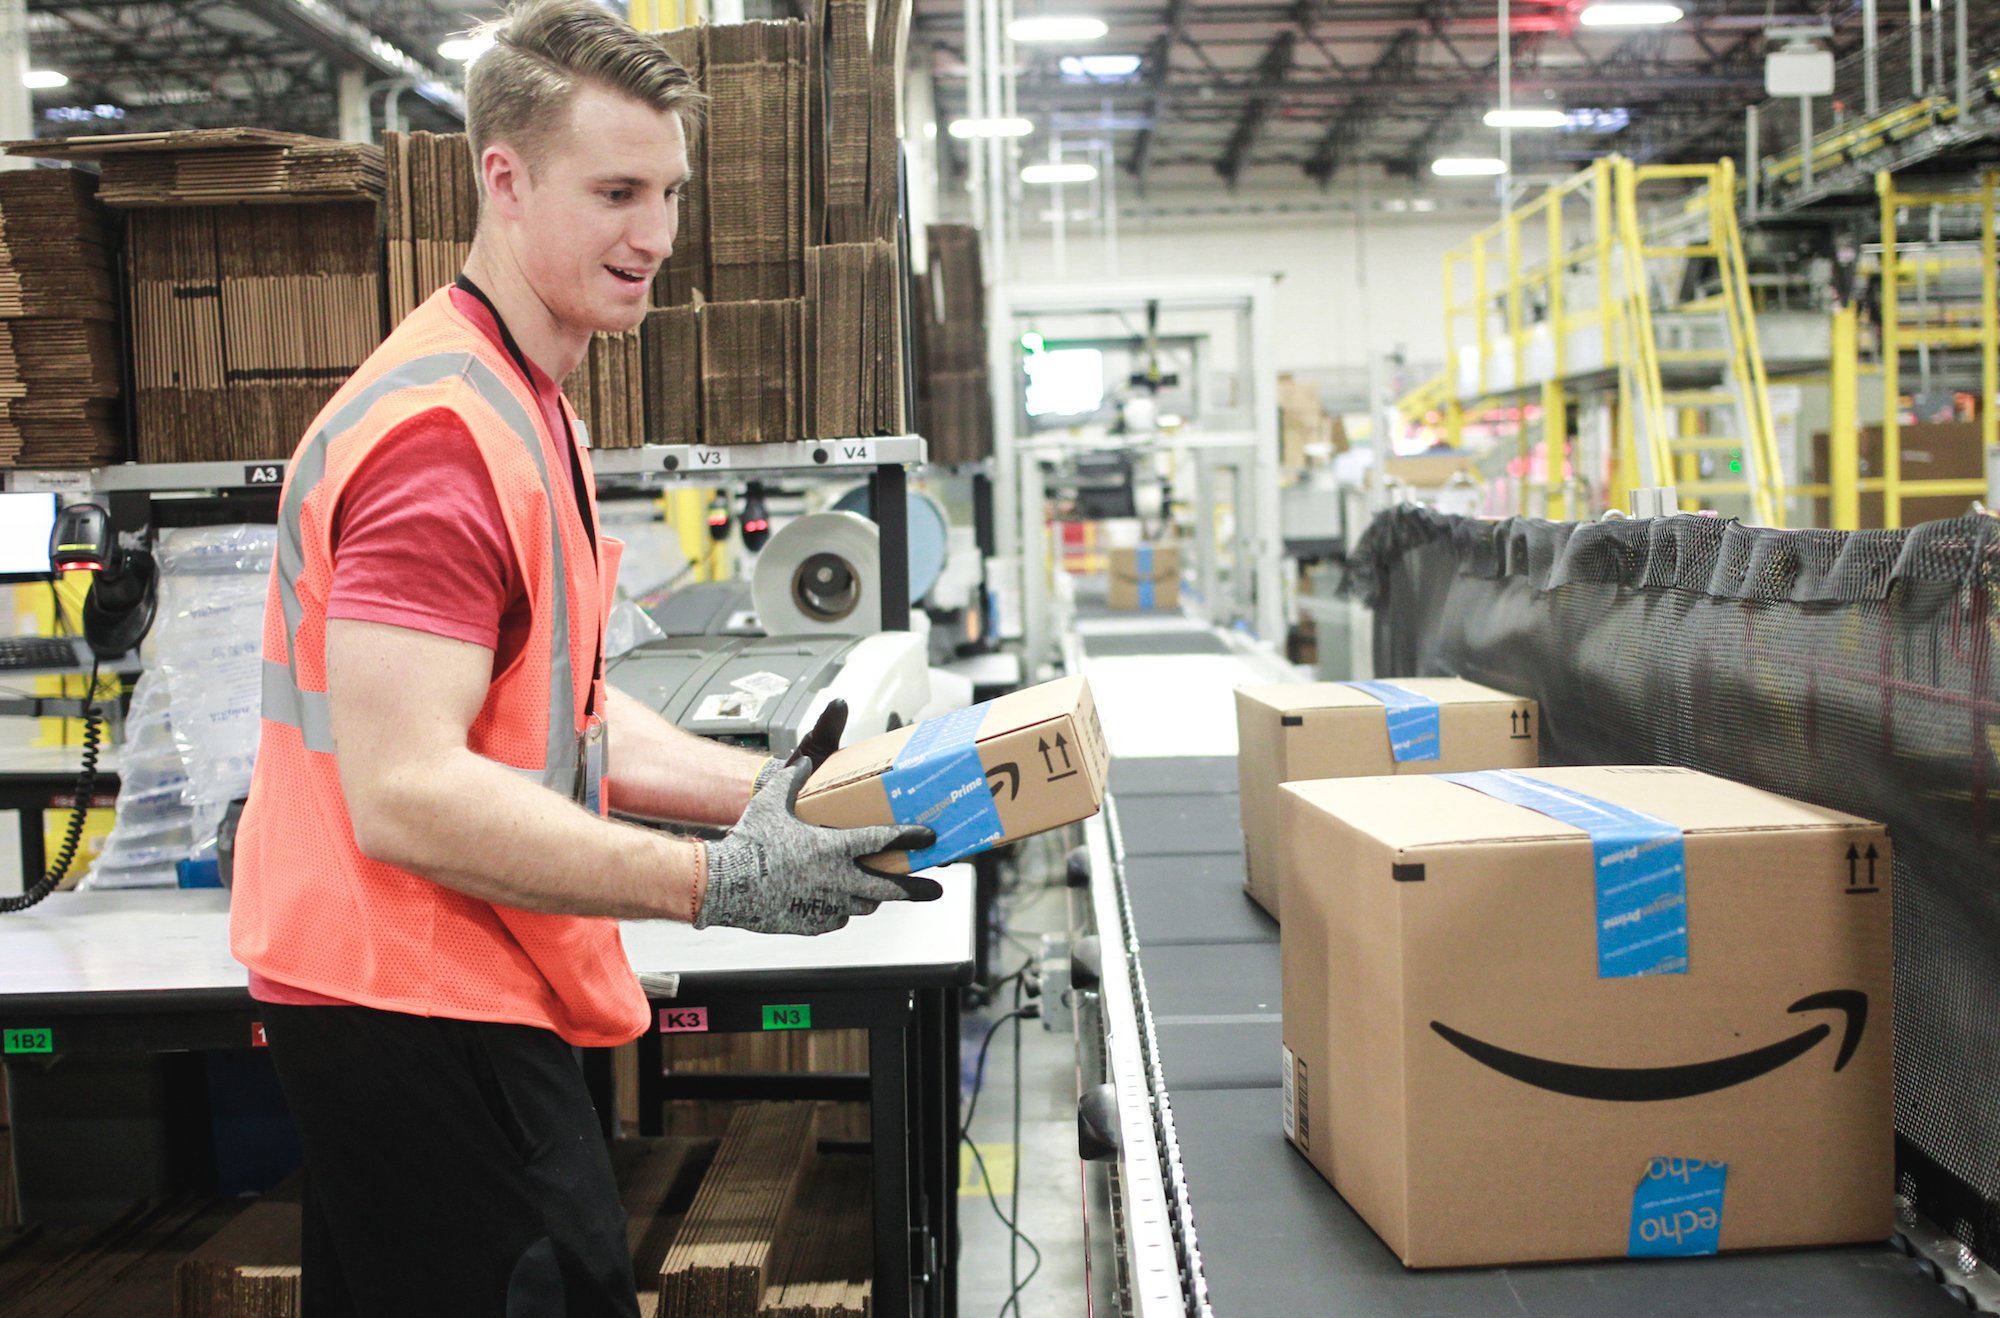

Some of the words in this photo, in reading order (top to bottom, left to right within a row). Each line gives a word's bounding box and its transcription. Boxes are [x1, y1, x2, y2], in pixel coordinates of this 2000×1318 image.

[698, 451, 722, 465] V3
[844, 447, 867, 460] V4
[251, 467, 277, 483] A3
[789, 897, 841, 919] HyFlex
[668, 1012, 701, 1028] K3
[773, 1010, 801, 1025] N3
[11, 1033, 46, 1049] 1B2
[1639, 1206, 1717, 1245] echo
